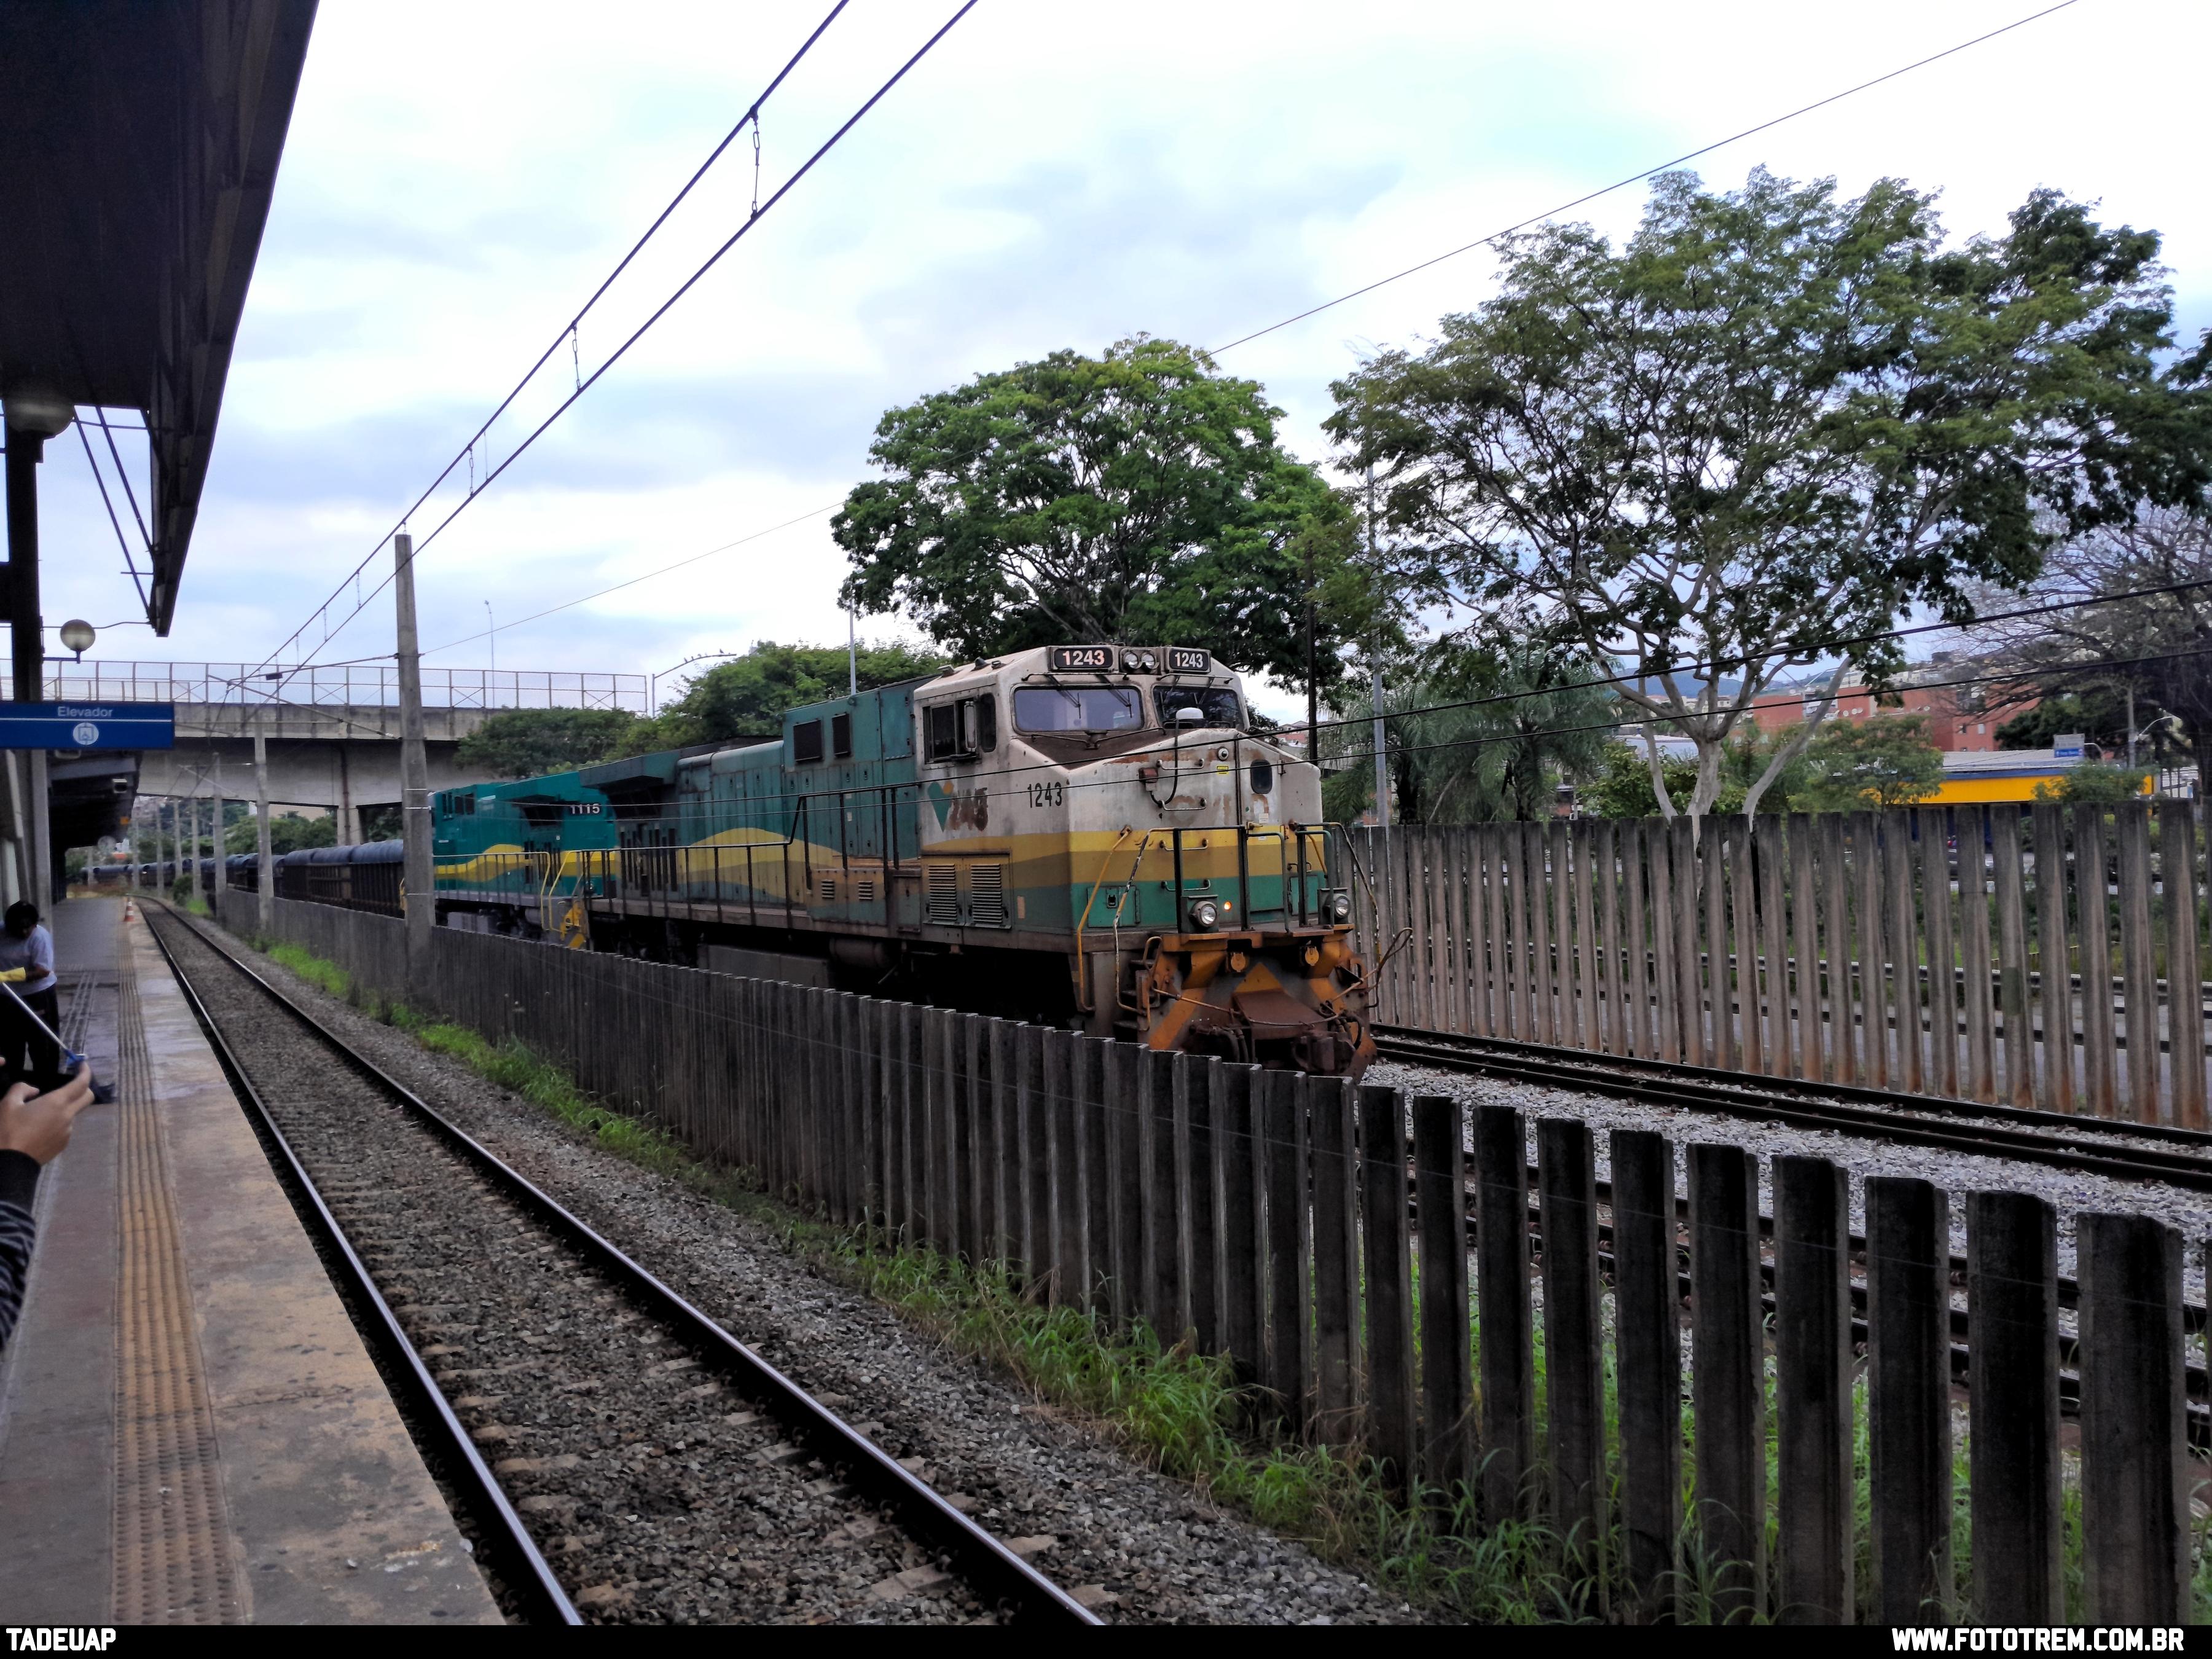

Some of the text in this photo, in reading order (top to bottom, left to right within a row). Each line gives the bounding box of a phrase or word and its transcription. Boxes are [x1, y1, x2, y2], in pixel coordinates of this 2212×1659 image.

[1062, 650, 1105, 665] 1243
[1174, 652, 1203, 669] 1243
[57, 706, 113, 717] Elevador
[1027, 782, 1062, 808] 1243
[570, 803, 600, 814] 1115
